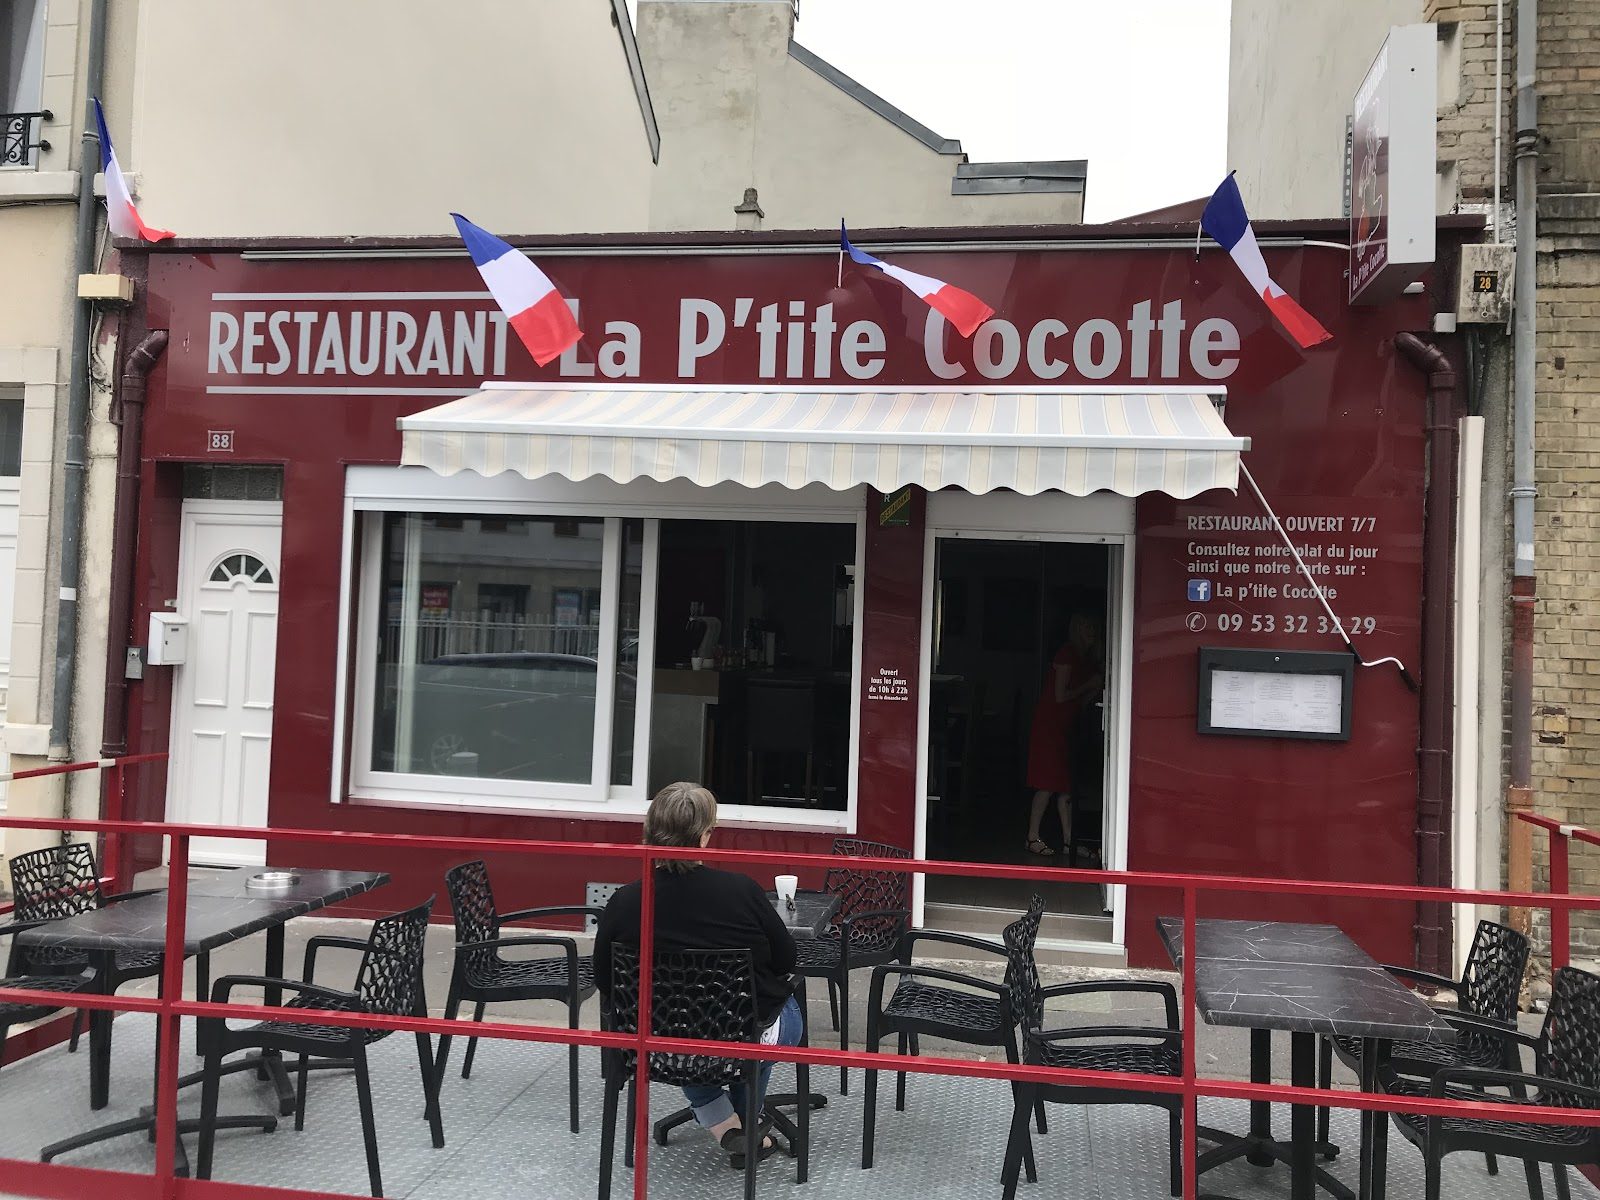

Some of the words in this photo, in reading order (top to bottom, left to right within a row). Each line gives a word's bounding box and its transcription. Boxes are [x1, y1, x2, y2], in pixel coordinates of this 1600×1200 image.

[1480, 277, 1491, 289] 28
[207, 310, 509, 375] RESTAURANT
[559, 298, 641, 378] La
[677, 298, 887, 379] P'tite
[924, 299, 1241, 380] Cocotte
[212, 434, 230, 448] 88
[1187, 515, 1281, 531] RESTAURANT
[1285, 516, 1345, 532] OUVERT
[1350, 517, 1377, 533] 7/7
[1187, 541, 1250, 556] Consultez
[1254, 544, 1291, 557] notre
[1296, 543, 1323, 558] plat
[1326, 544, 1345, 558] du
[1348, 545, 1379, 562] jour
[1187, 560, 1219, 573] ainsi
[1223, 562, 1250, 577] que
[1255, 561, 1291, 574] notre
[1335, 565, 1357, 576] sur
[1361, 565, 1366, 576] :
[1216, 582, 1233, 597] La
[1238, 583, 1277, 601] p'tite
[1217, 613, 1243, 632] 09
[1250, 614, 1275, 633] 53
[1283, 615, 1308, 633] 32
[1316, 615, 1341, 634] 32
[1350, 616, 1377, 635] 29
[879, 667, 899, 676] Ouvert
[868, 685, 877, 693] de
[878, 685, 890, 694] 10h
[890, 686, 895, 694] à
[896, 686, 908, 695] 22h
[870, 676, 883, 684] tous
[883, 676, 892, 685] les
[892, 677, 907, 687] jours
